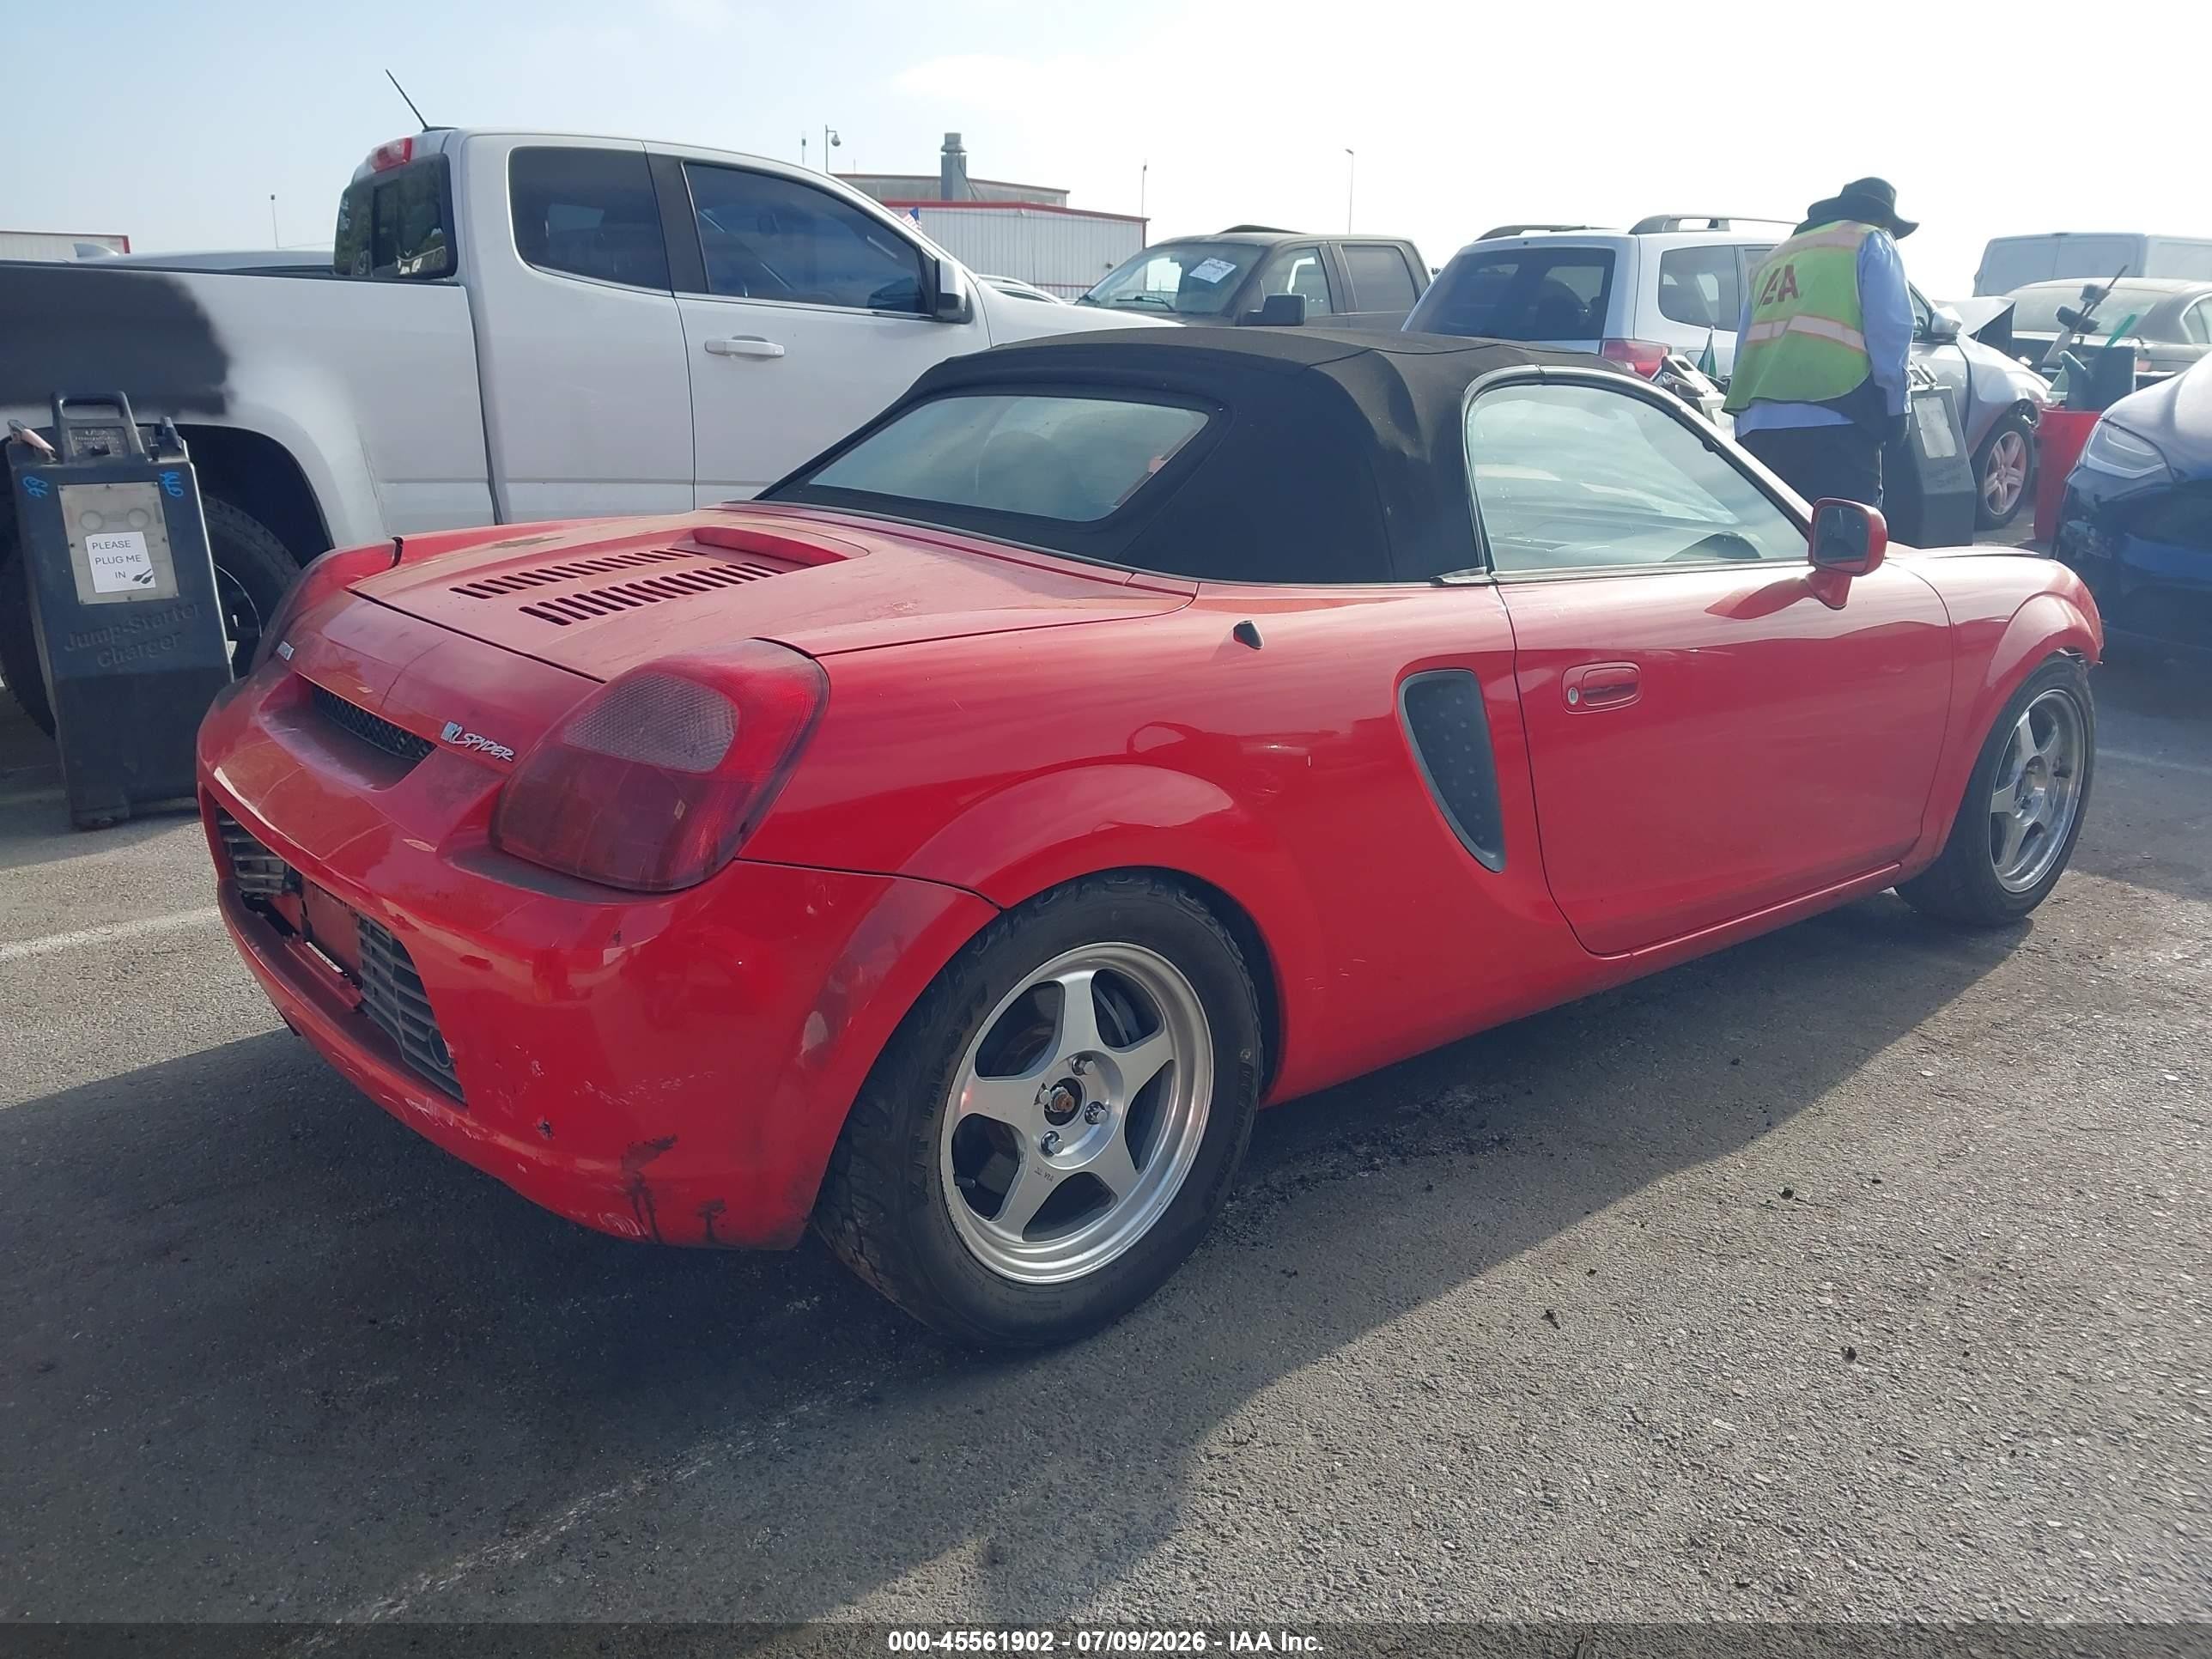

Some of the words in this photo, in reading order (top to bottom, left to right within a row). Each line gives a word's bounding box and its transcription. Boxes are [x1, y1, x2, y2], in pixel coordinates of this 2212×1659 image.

[92, 540, 131, 550] PLEASE
[95, 556, 124, 566] PLUG
[126, 554, 142, 563] ME
[115, 571, 126, 580] IN
[97, 631, 182, 667] Charger
[464, 732, 514, 762] SPYDER
